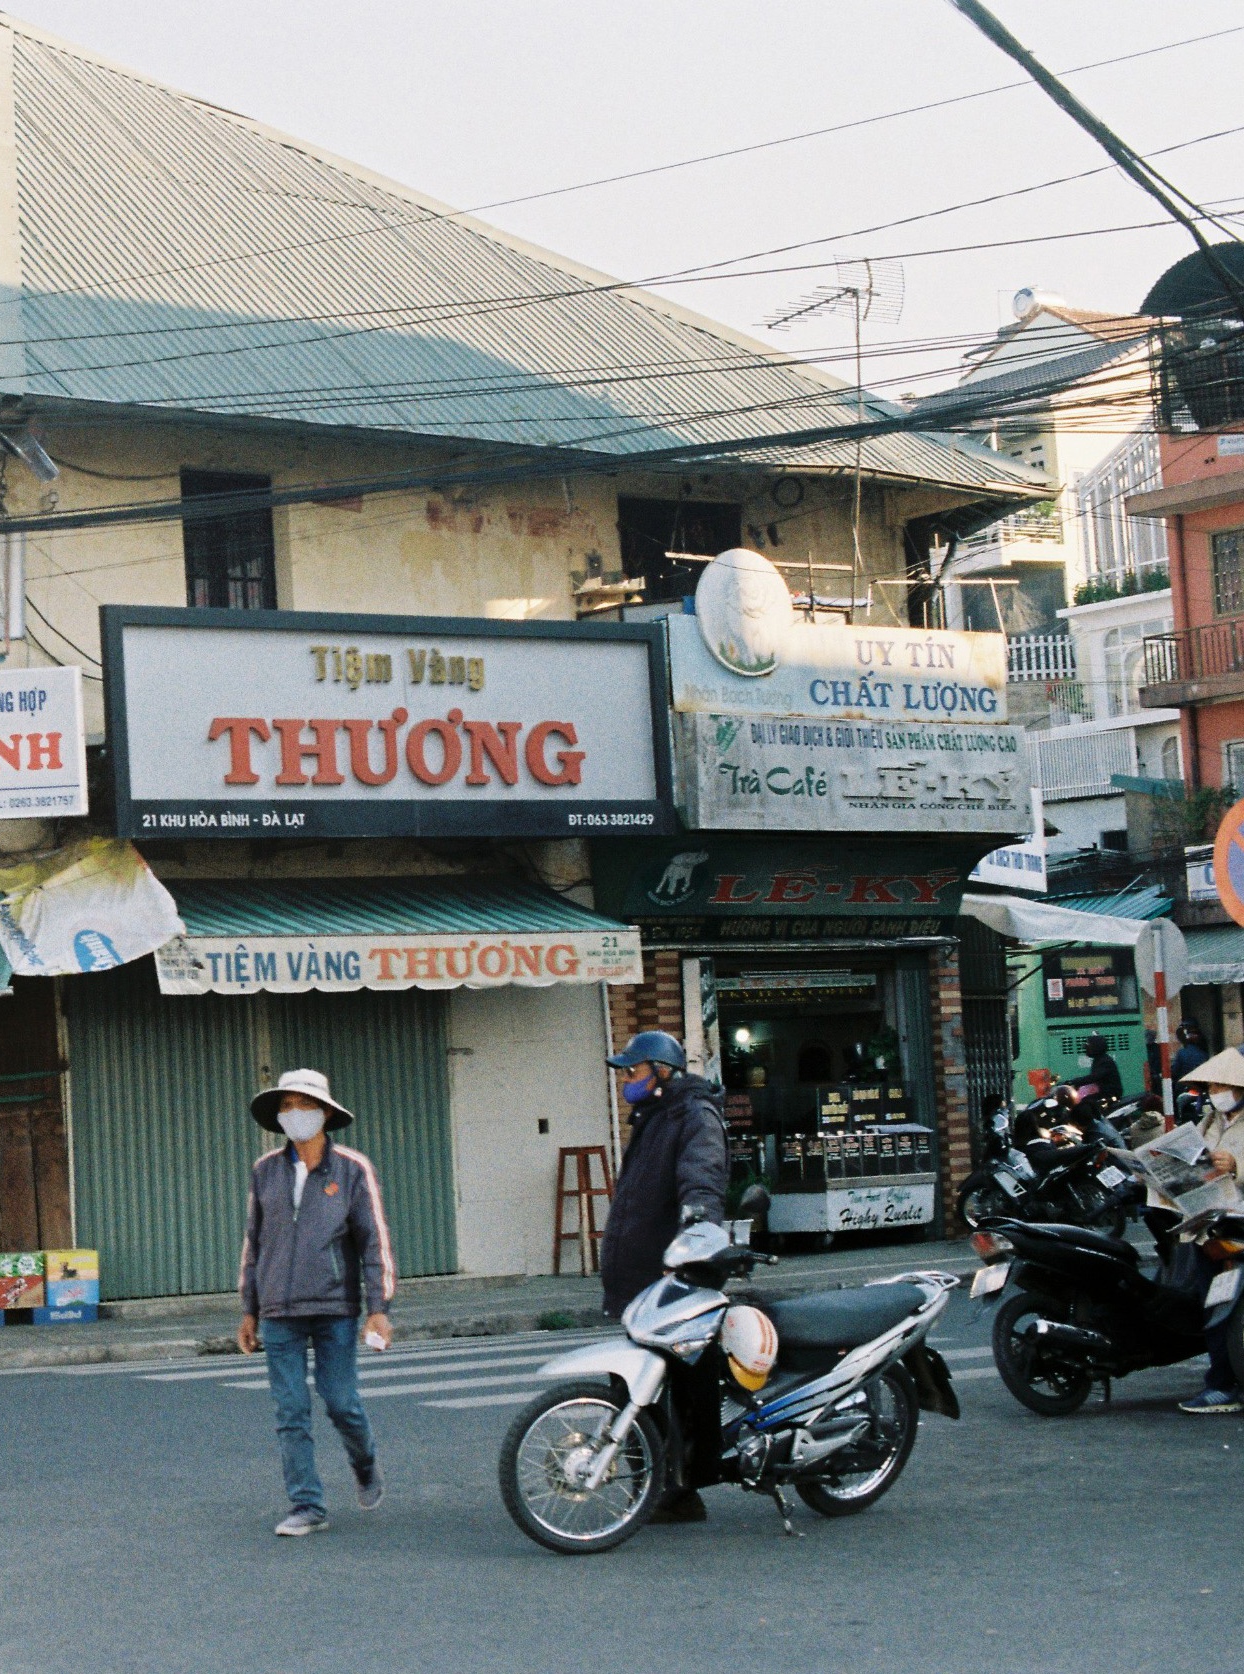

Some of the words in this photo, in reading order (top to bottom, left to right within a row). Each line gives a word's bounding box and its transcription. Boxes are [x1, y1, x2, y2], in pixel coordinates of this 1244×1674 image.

[310, 646, 392, 690] Tiệm
[407, 648, 484, 690] Vàng
[855, 640, 894, 666] UY
[905, 636, 955, 668] TÍN
[19, 687, 47, 717] HỢP
[810, 670, 893, 707] CHẤT
[902, 681, 997, 717] LƯỢNG
[208, 707, 586, 785] THƯƠNG
[997, 735, 1016, 752] CAO
[718, 763, 761, 795] Trà
[766, 766, 827, 797] Café
[142, 814, 156, 827] 21
[160, 814, 186, 827] KHU
[189, 811, 217, 827] HÒA
[220, 811, 250, 827] BÌNH
[262, 811, 281, 826] ĐÀ
[284, 813, 305, 829] LẠT
[601, 937, 618, 948] 21
[206, 943, 277, 989] TIỆM
[286, 943, 361, 981] VÀNG
[368, 940, 581, 981] THƯƠNG
